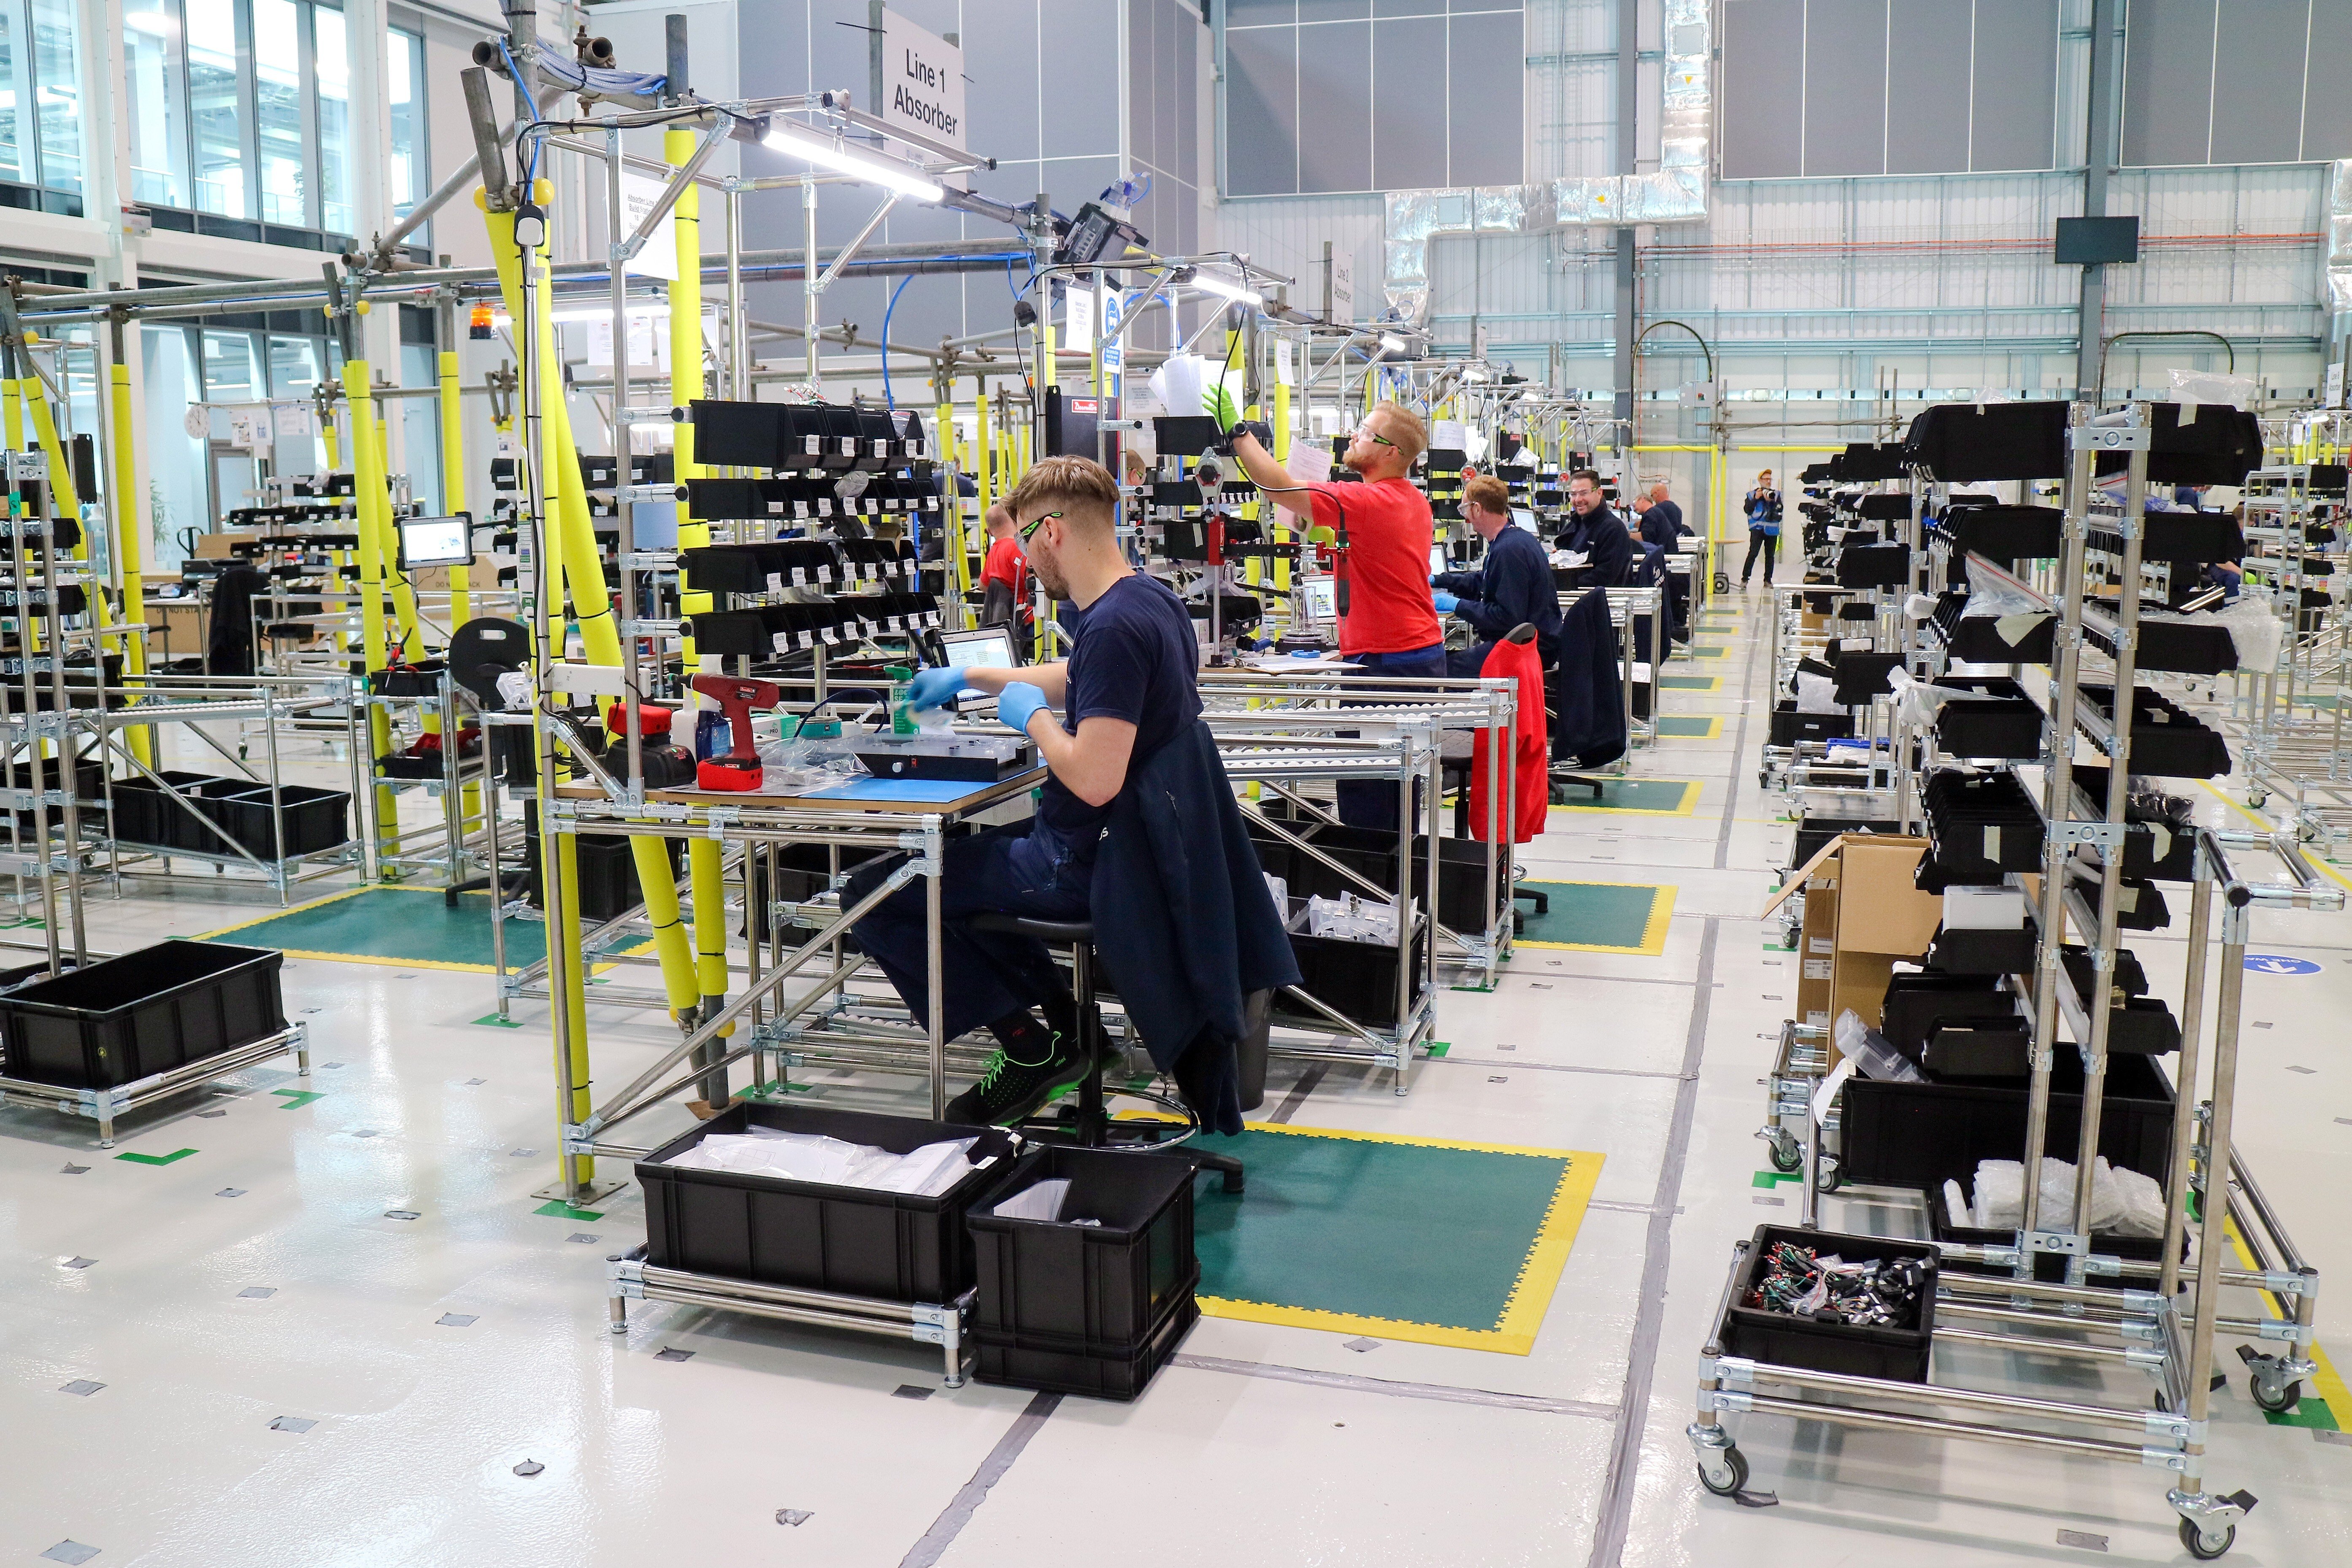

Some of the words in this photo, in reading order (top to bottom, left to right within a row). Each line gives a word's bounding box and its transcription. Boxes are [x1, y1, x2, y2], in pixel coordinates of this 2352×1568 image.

[907, 48, 935, 88] Line
[940, 68, 945, 93] 1
[894, 84, 957, 136] Absorber
[628, 194, 645, 203] Absorber
[629, 203, 639, 211] Build
[1346, 268, 1349, 283] 2
[1335, 283, 1351, 303] Absorber
